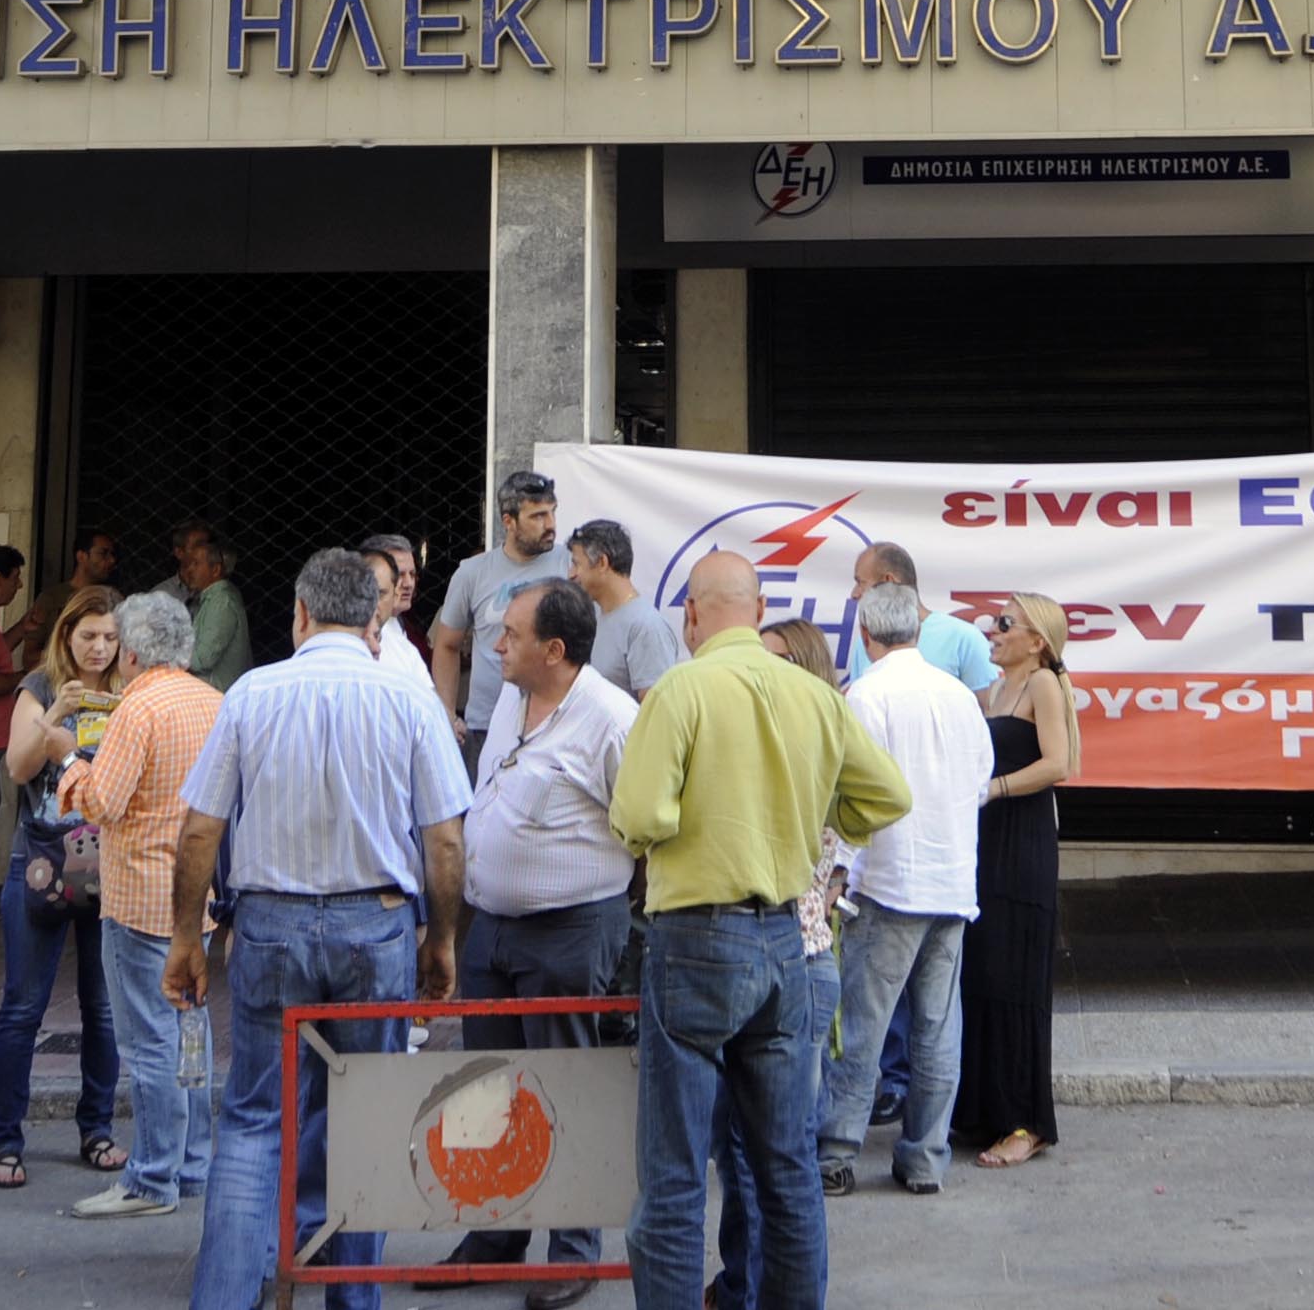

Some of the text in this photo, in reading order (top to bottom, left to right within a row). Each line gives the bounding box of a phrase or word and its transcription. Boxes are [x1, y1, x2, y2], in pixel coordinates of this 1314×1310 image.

[757, 144, 826, 197] ΔΕΗ
[890, 155, 1270, 178] ΔΗΜΟΣΙΑ ΕΠΙΧΕΙΡΗΣΗ ΗΛΕΚΤΡΙΣΜΟΥ Α.Ε.
[941, 478, 1194, 527] είναι
